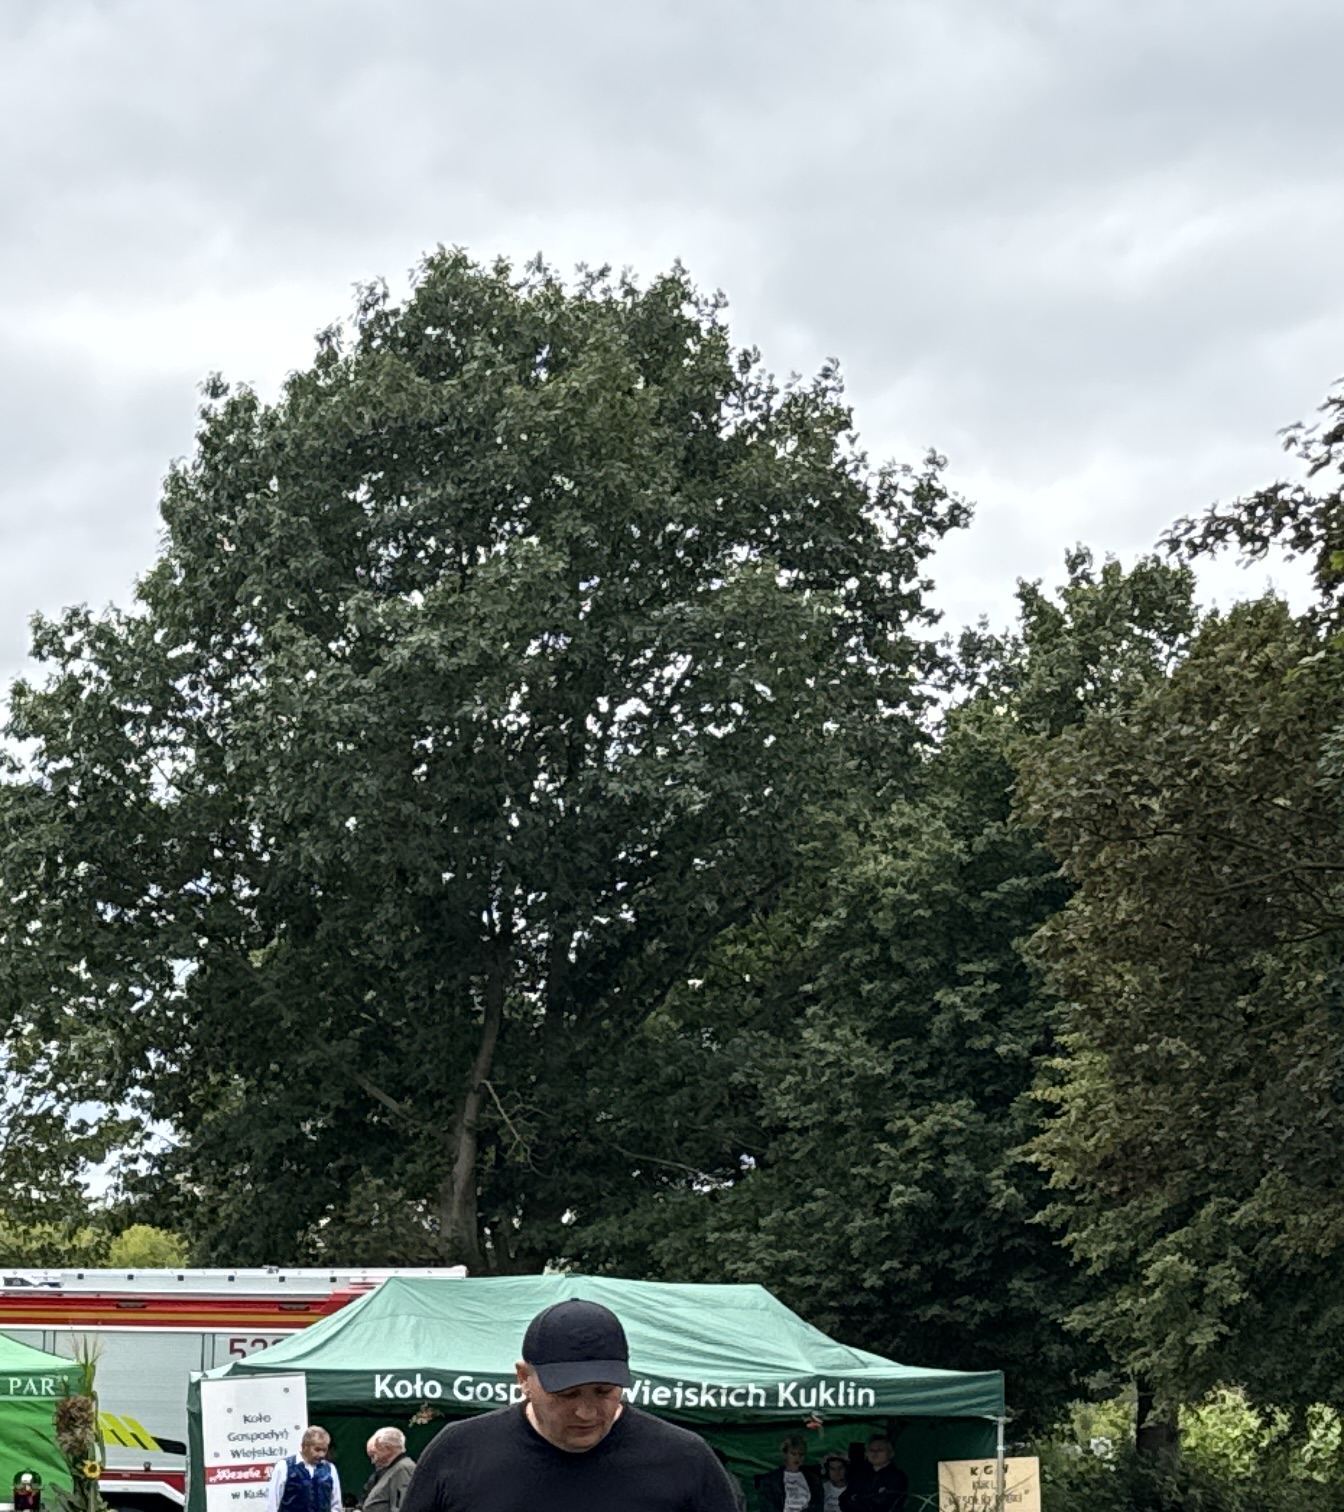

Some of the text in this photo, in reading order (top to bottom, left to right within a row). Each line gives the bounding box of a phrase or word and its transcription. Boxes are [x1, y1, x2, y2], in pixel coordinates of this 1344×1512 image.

[374, 1374, 442, 1399] Koło
[777, 1380, 876, 1408] Kuklin
[243, 1413, 271, 1424] Koło
[227, 1428, 289, 1443] Gospodyń
